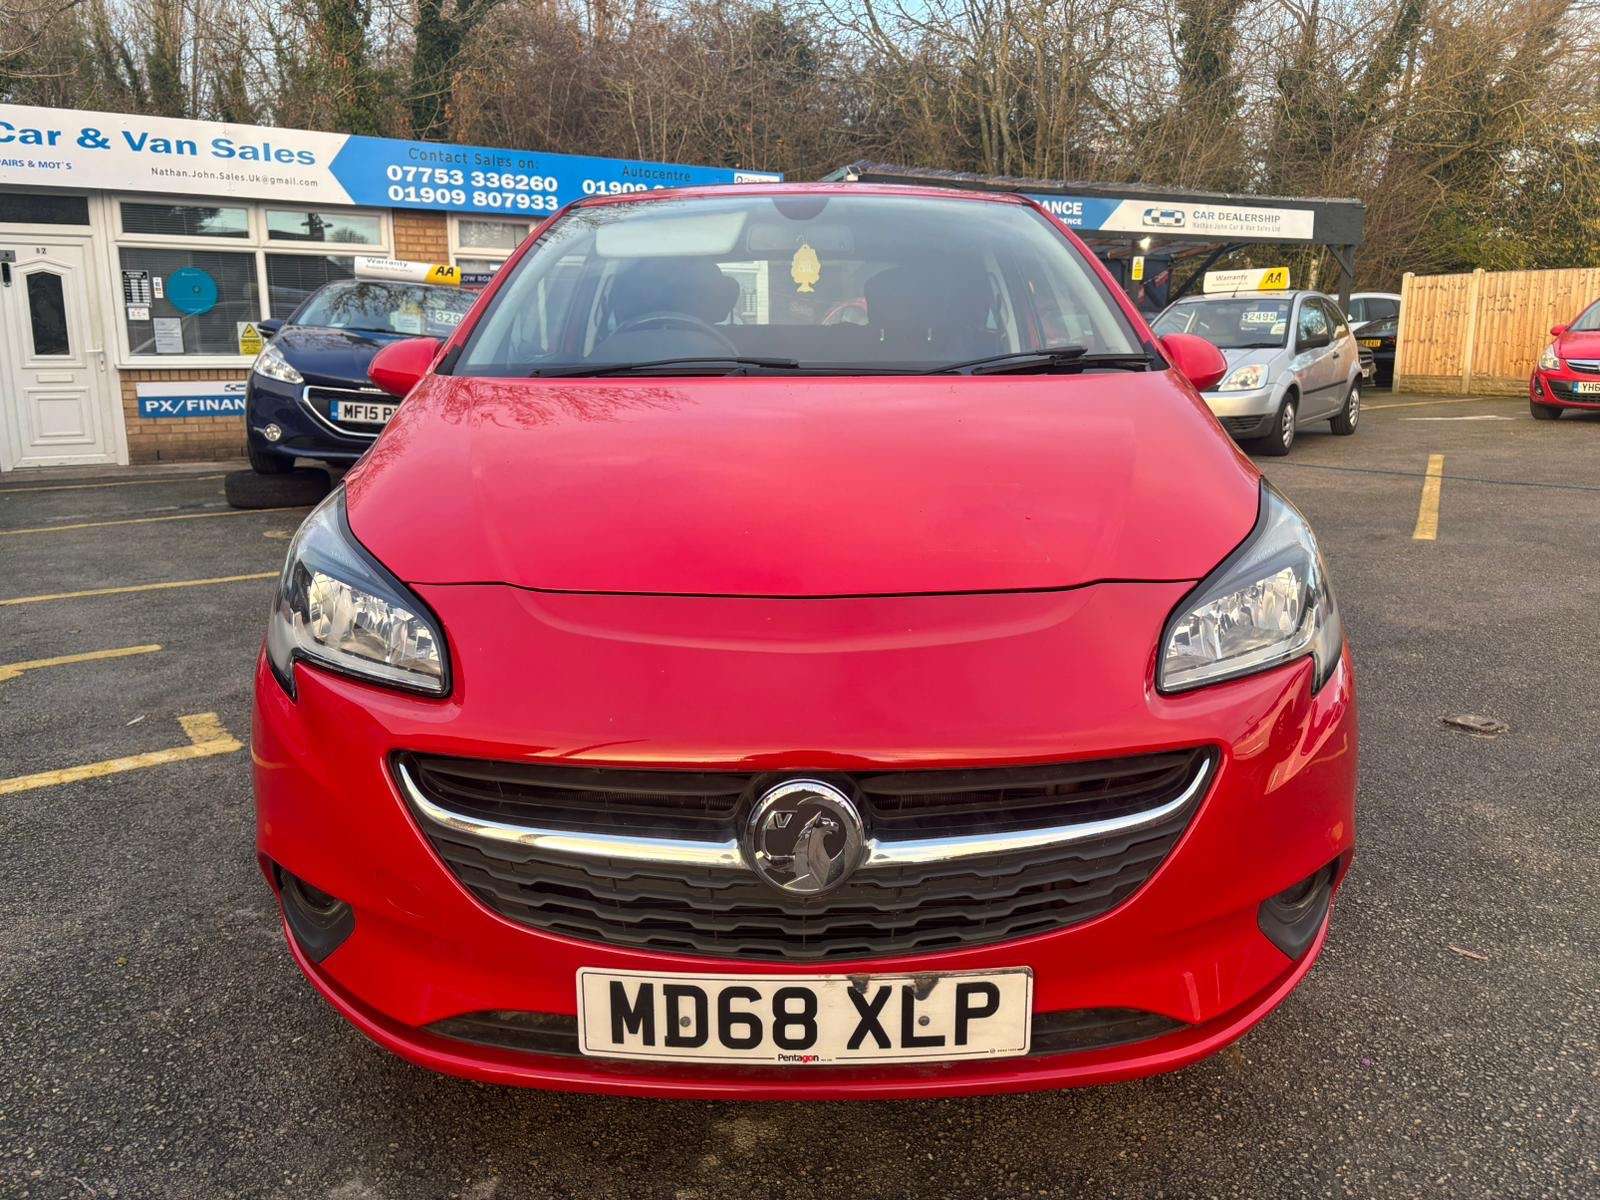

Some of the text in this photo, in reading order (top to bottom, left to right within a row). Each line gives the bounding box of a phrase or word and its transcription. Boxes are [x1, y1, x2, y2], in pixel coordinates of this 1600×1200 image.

[0, 121, 316, 165] Car & Van Sales
[0, 158, 24, 167] AIRS
[408, 148, 539, 170] Contact Sales on:
[386, 165, 558, 192] 07753 336260
[623, 165, 692, 183] Autocentre
[388, 185, 559, 211] 01909 807933
[1034, 200, 1083, 215] ANCE
[1192, 210, 1281, 223] CAR DEALERSHIP
[435, 266, 454, 277] AA
[1265, 272, 1282, 283] AA
[344, 404, 398, 421] MF15 P
[609, 980, 1001, 1050] MD68 XLP
[777, 1053, 819, 1063] Pentagon
